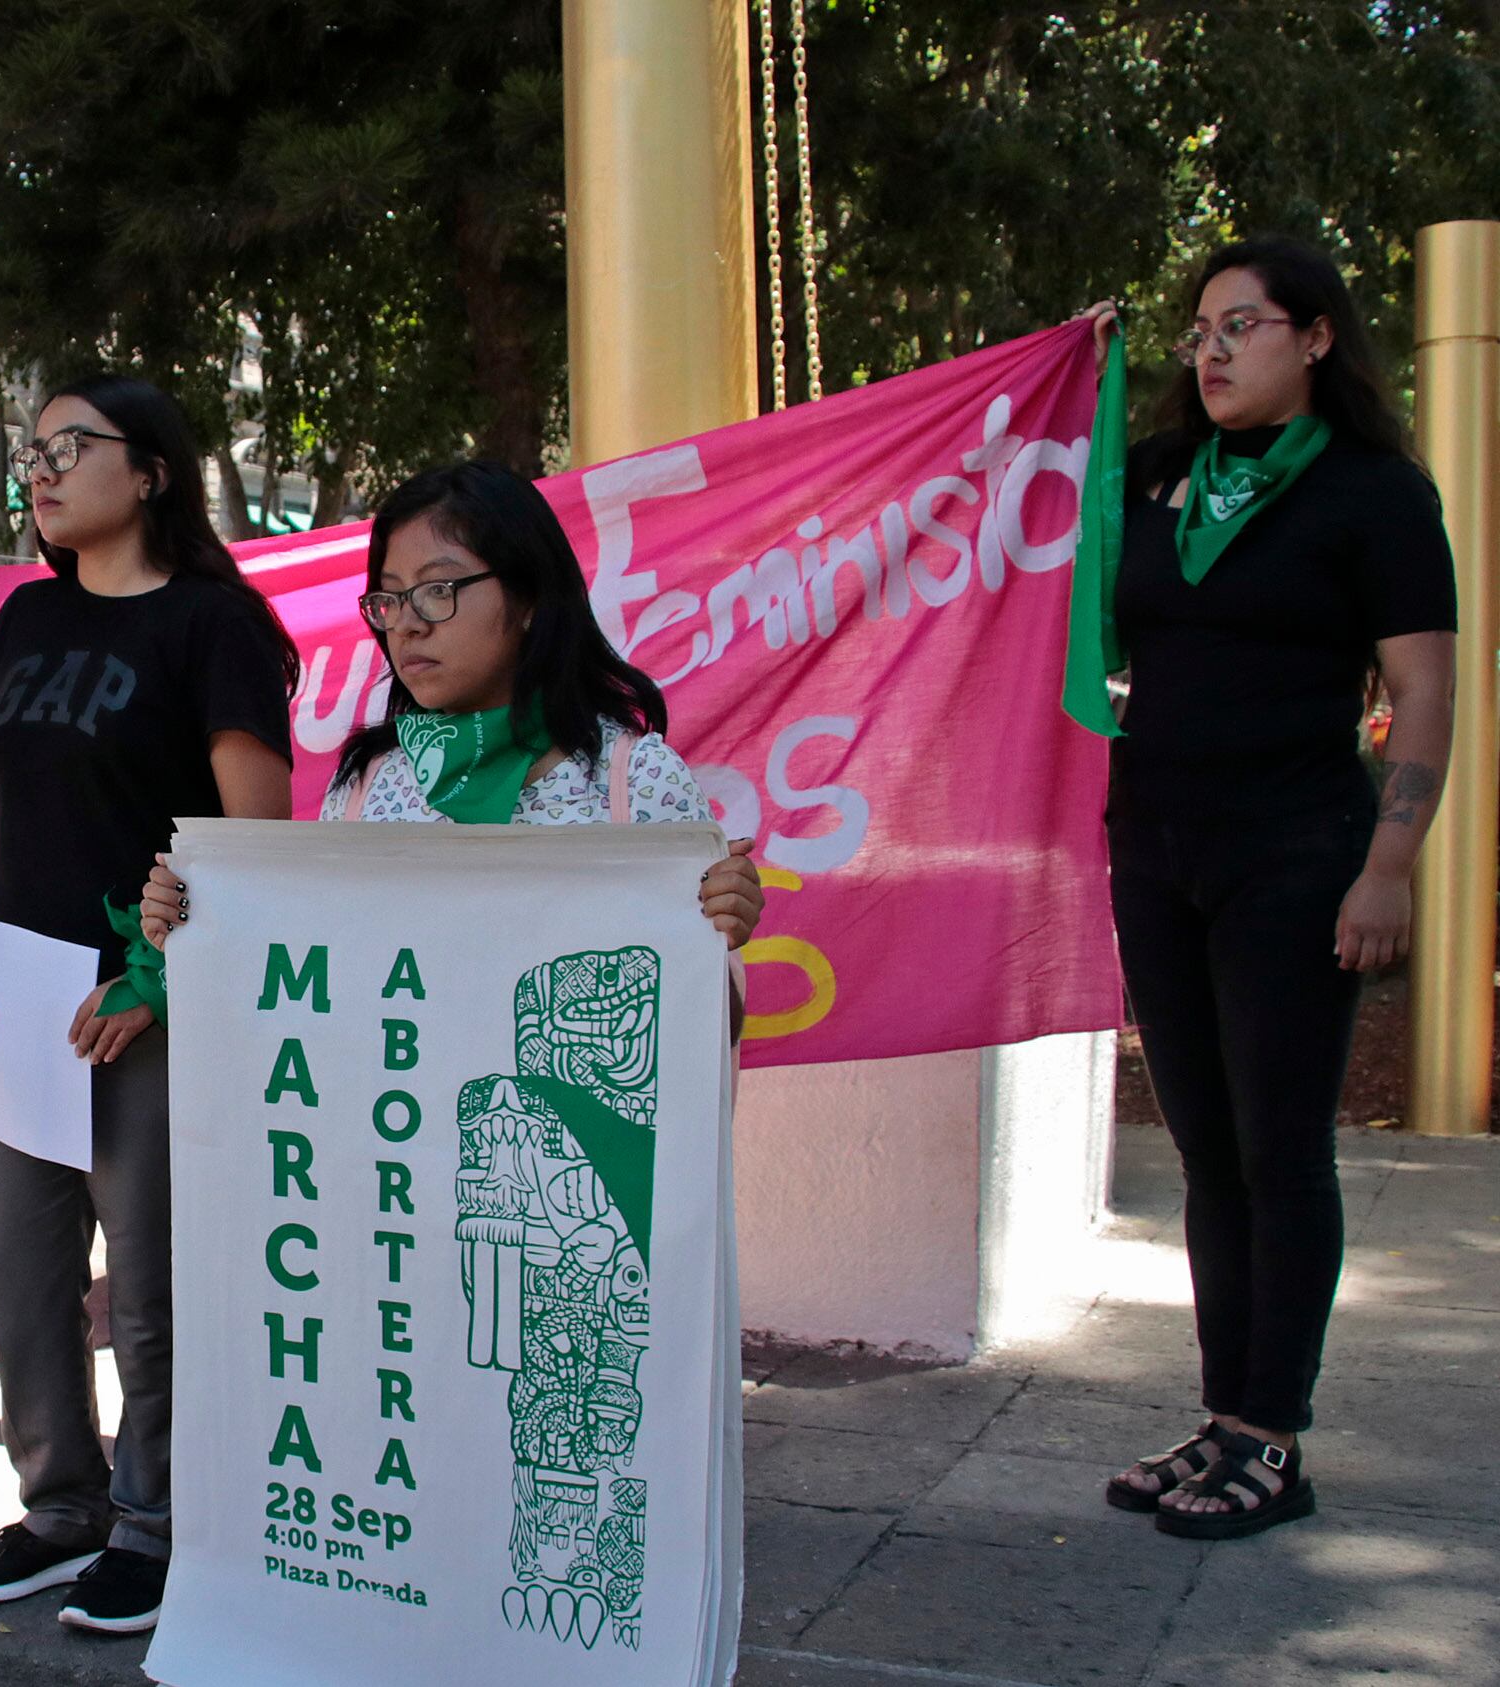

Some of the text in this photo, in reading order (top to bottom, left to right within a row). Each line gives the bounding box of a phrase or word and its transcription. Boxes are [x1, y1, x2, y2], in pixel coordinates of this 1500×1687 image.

[582, 394, 1090, 688] Feminista
[257, 943, 331, 1473] MARCHA
[372, 947, 426, 1490] ABORTERA
[264, 1523, 364, 1560] 4:00 pm
[264, 1555, 329, 1587] Plaza
[266, 1482, 412, 1550] 28 Sep
